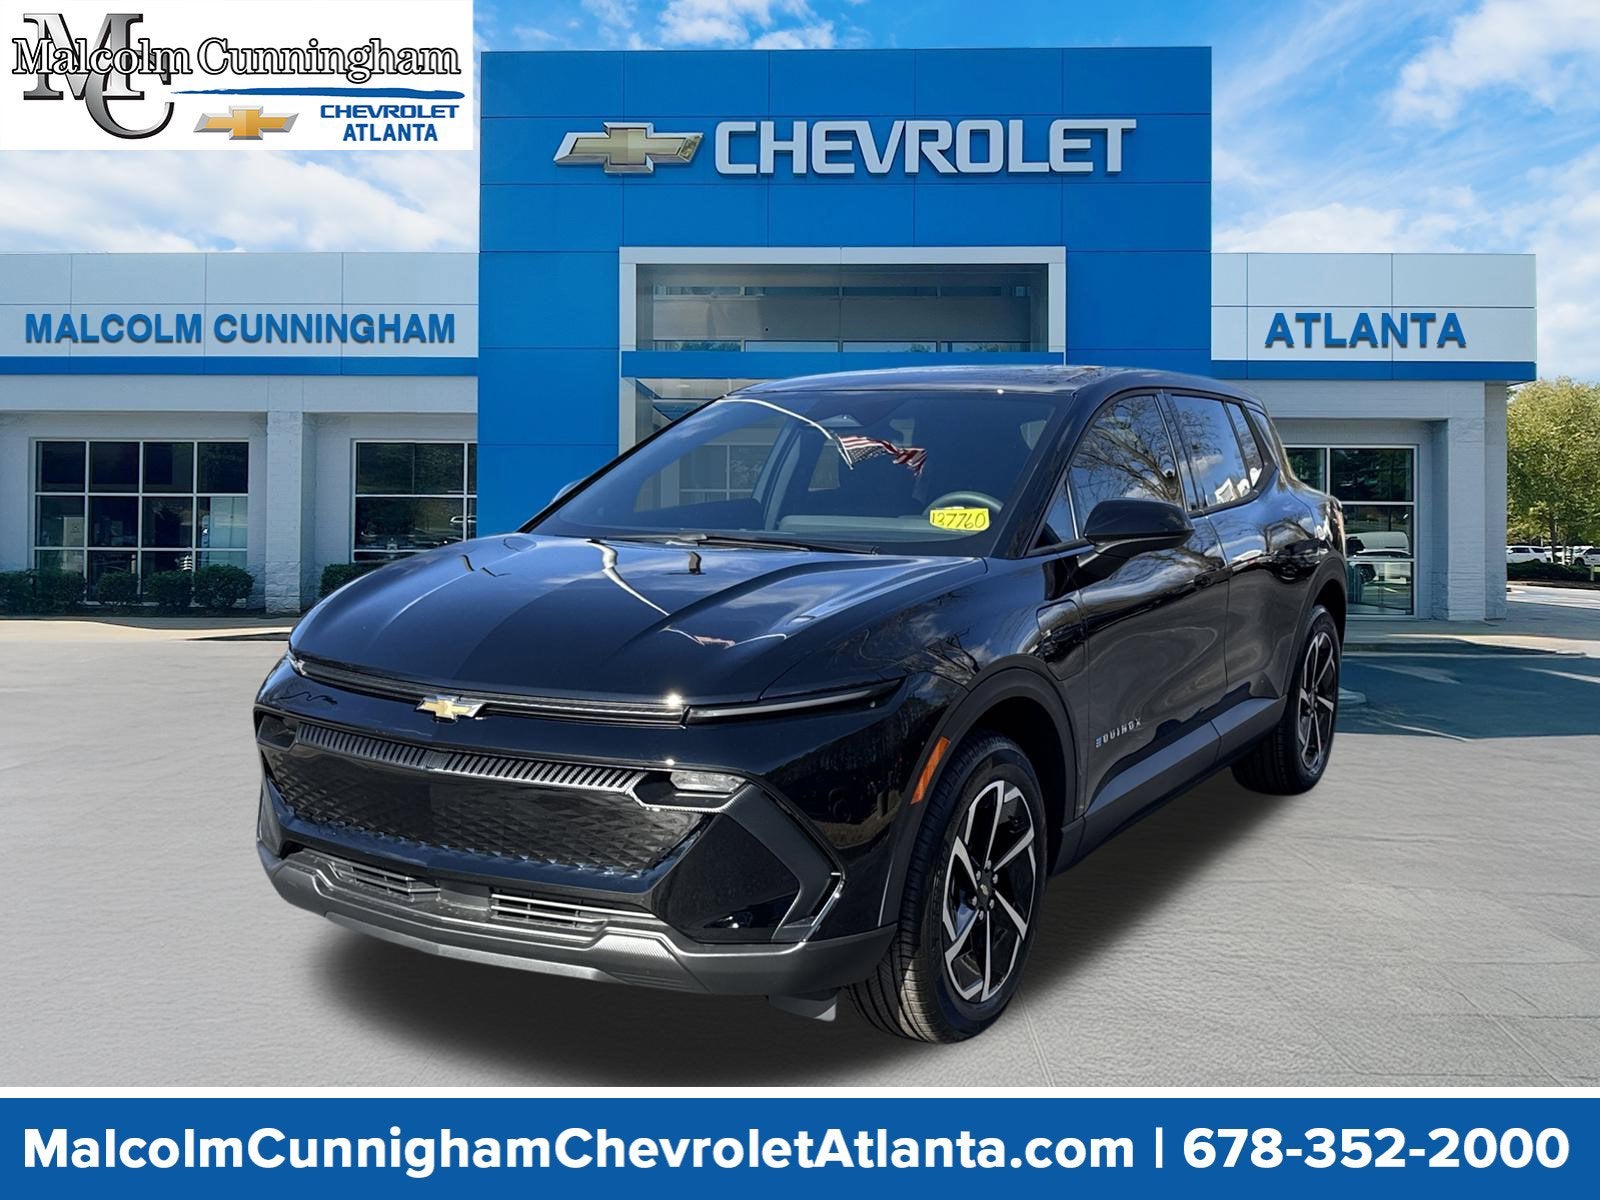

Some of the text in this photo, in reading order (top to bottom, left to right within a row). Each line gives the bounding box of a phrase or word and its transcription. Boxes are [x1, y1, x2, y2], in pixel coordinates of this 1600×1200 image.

[715, 119, 1137, 175] CHEVROLET
[25, 313, 456, 343] MALCOLM CUNNINGHAM
[1264, 312, 1467, 348] ATLANTA
